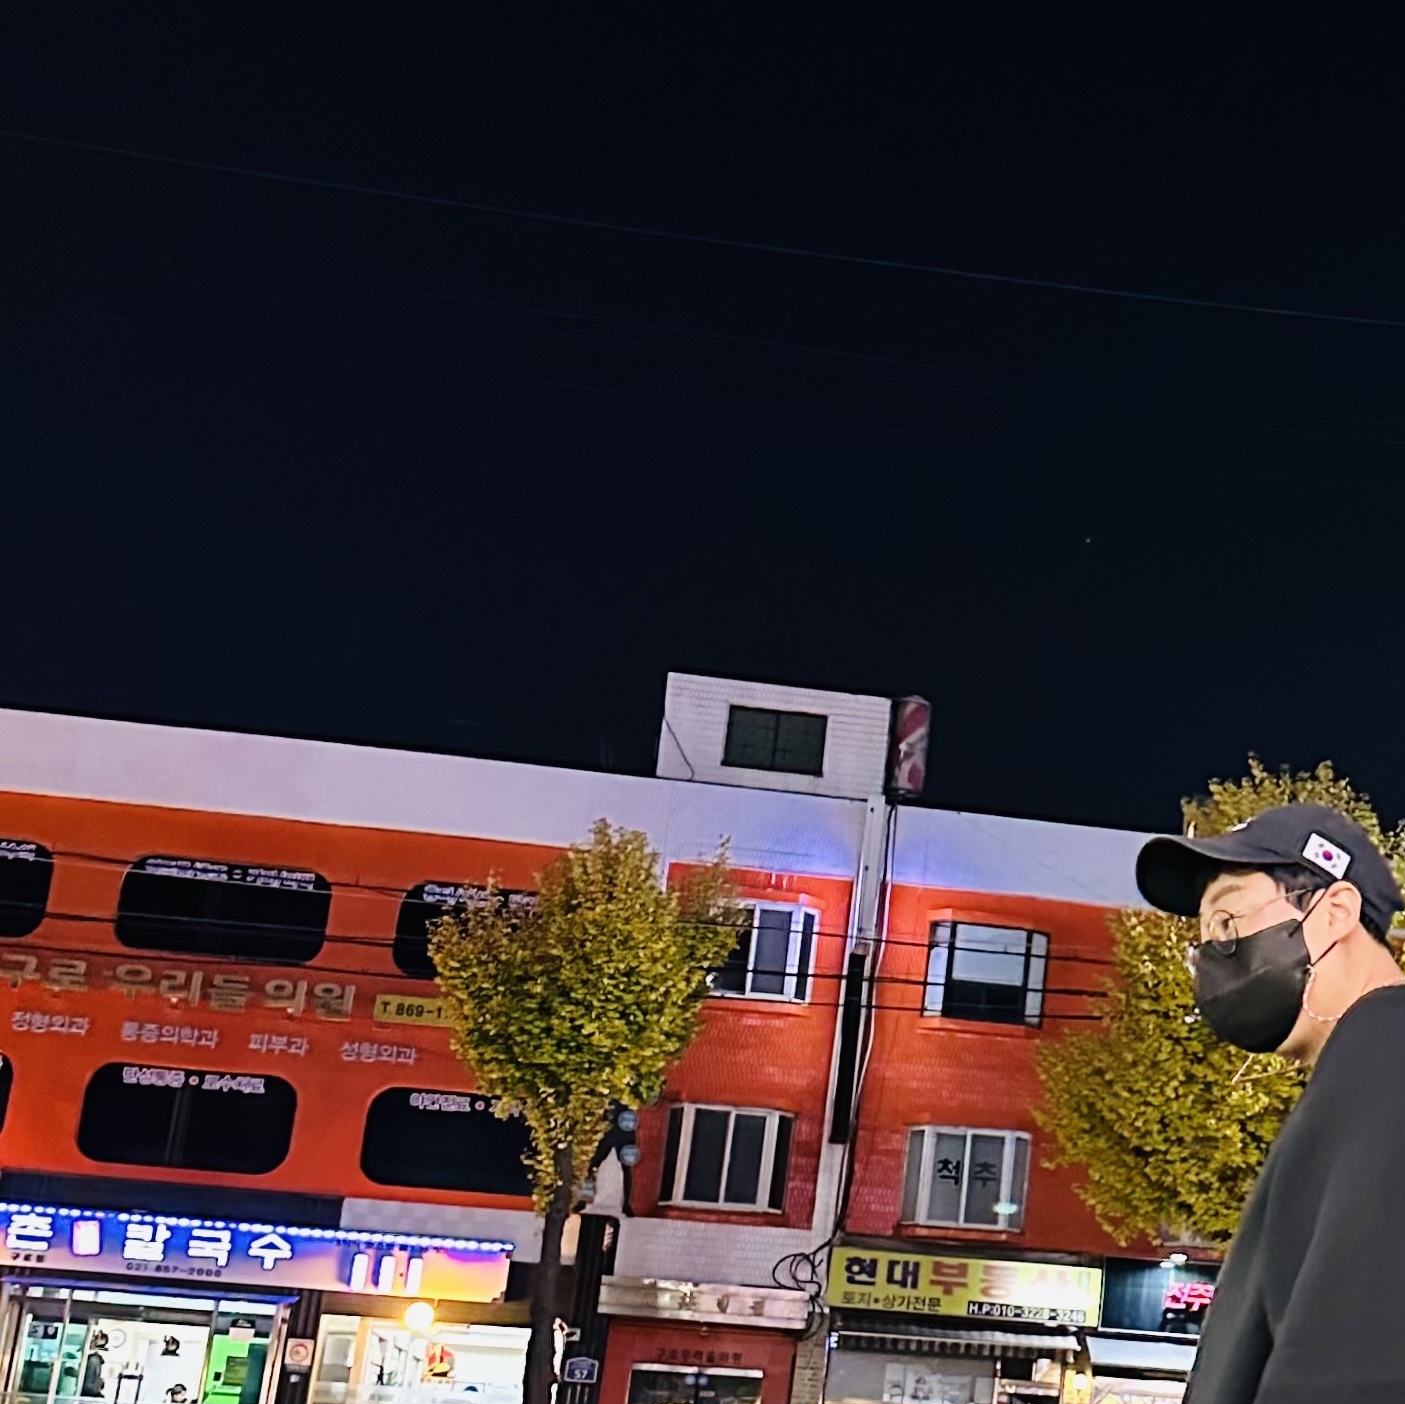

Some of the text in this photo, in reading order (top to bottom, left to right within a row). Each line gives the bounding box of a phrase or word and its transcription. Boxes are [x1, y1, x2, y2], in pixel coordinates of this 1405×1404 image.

[0, 953, 356, 1022] 구로 우리들 의원
[395, 1003, 450, 1020] 869-1
[12, 1011, 417, 1065] 정형외과 통증의학과 피부과 성형외과
[937, 1158, 998, 1189] 척추
[6, 1213, 53, 1251] 촌
[122, 1223, 294, 1271] 칼국수
[844, 1256, 920, 1290] 현대
